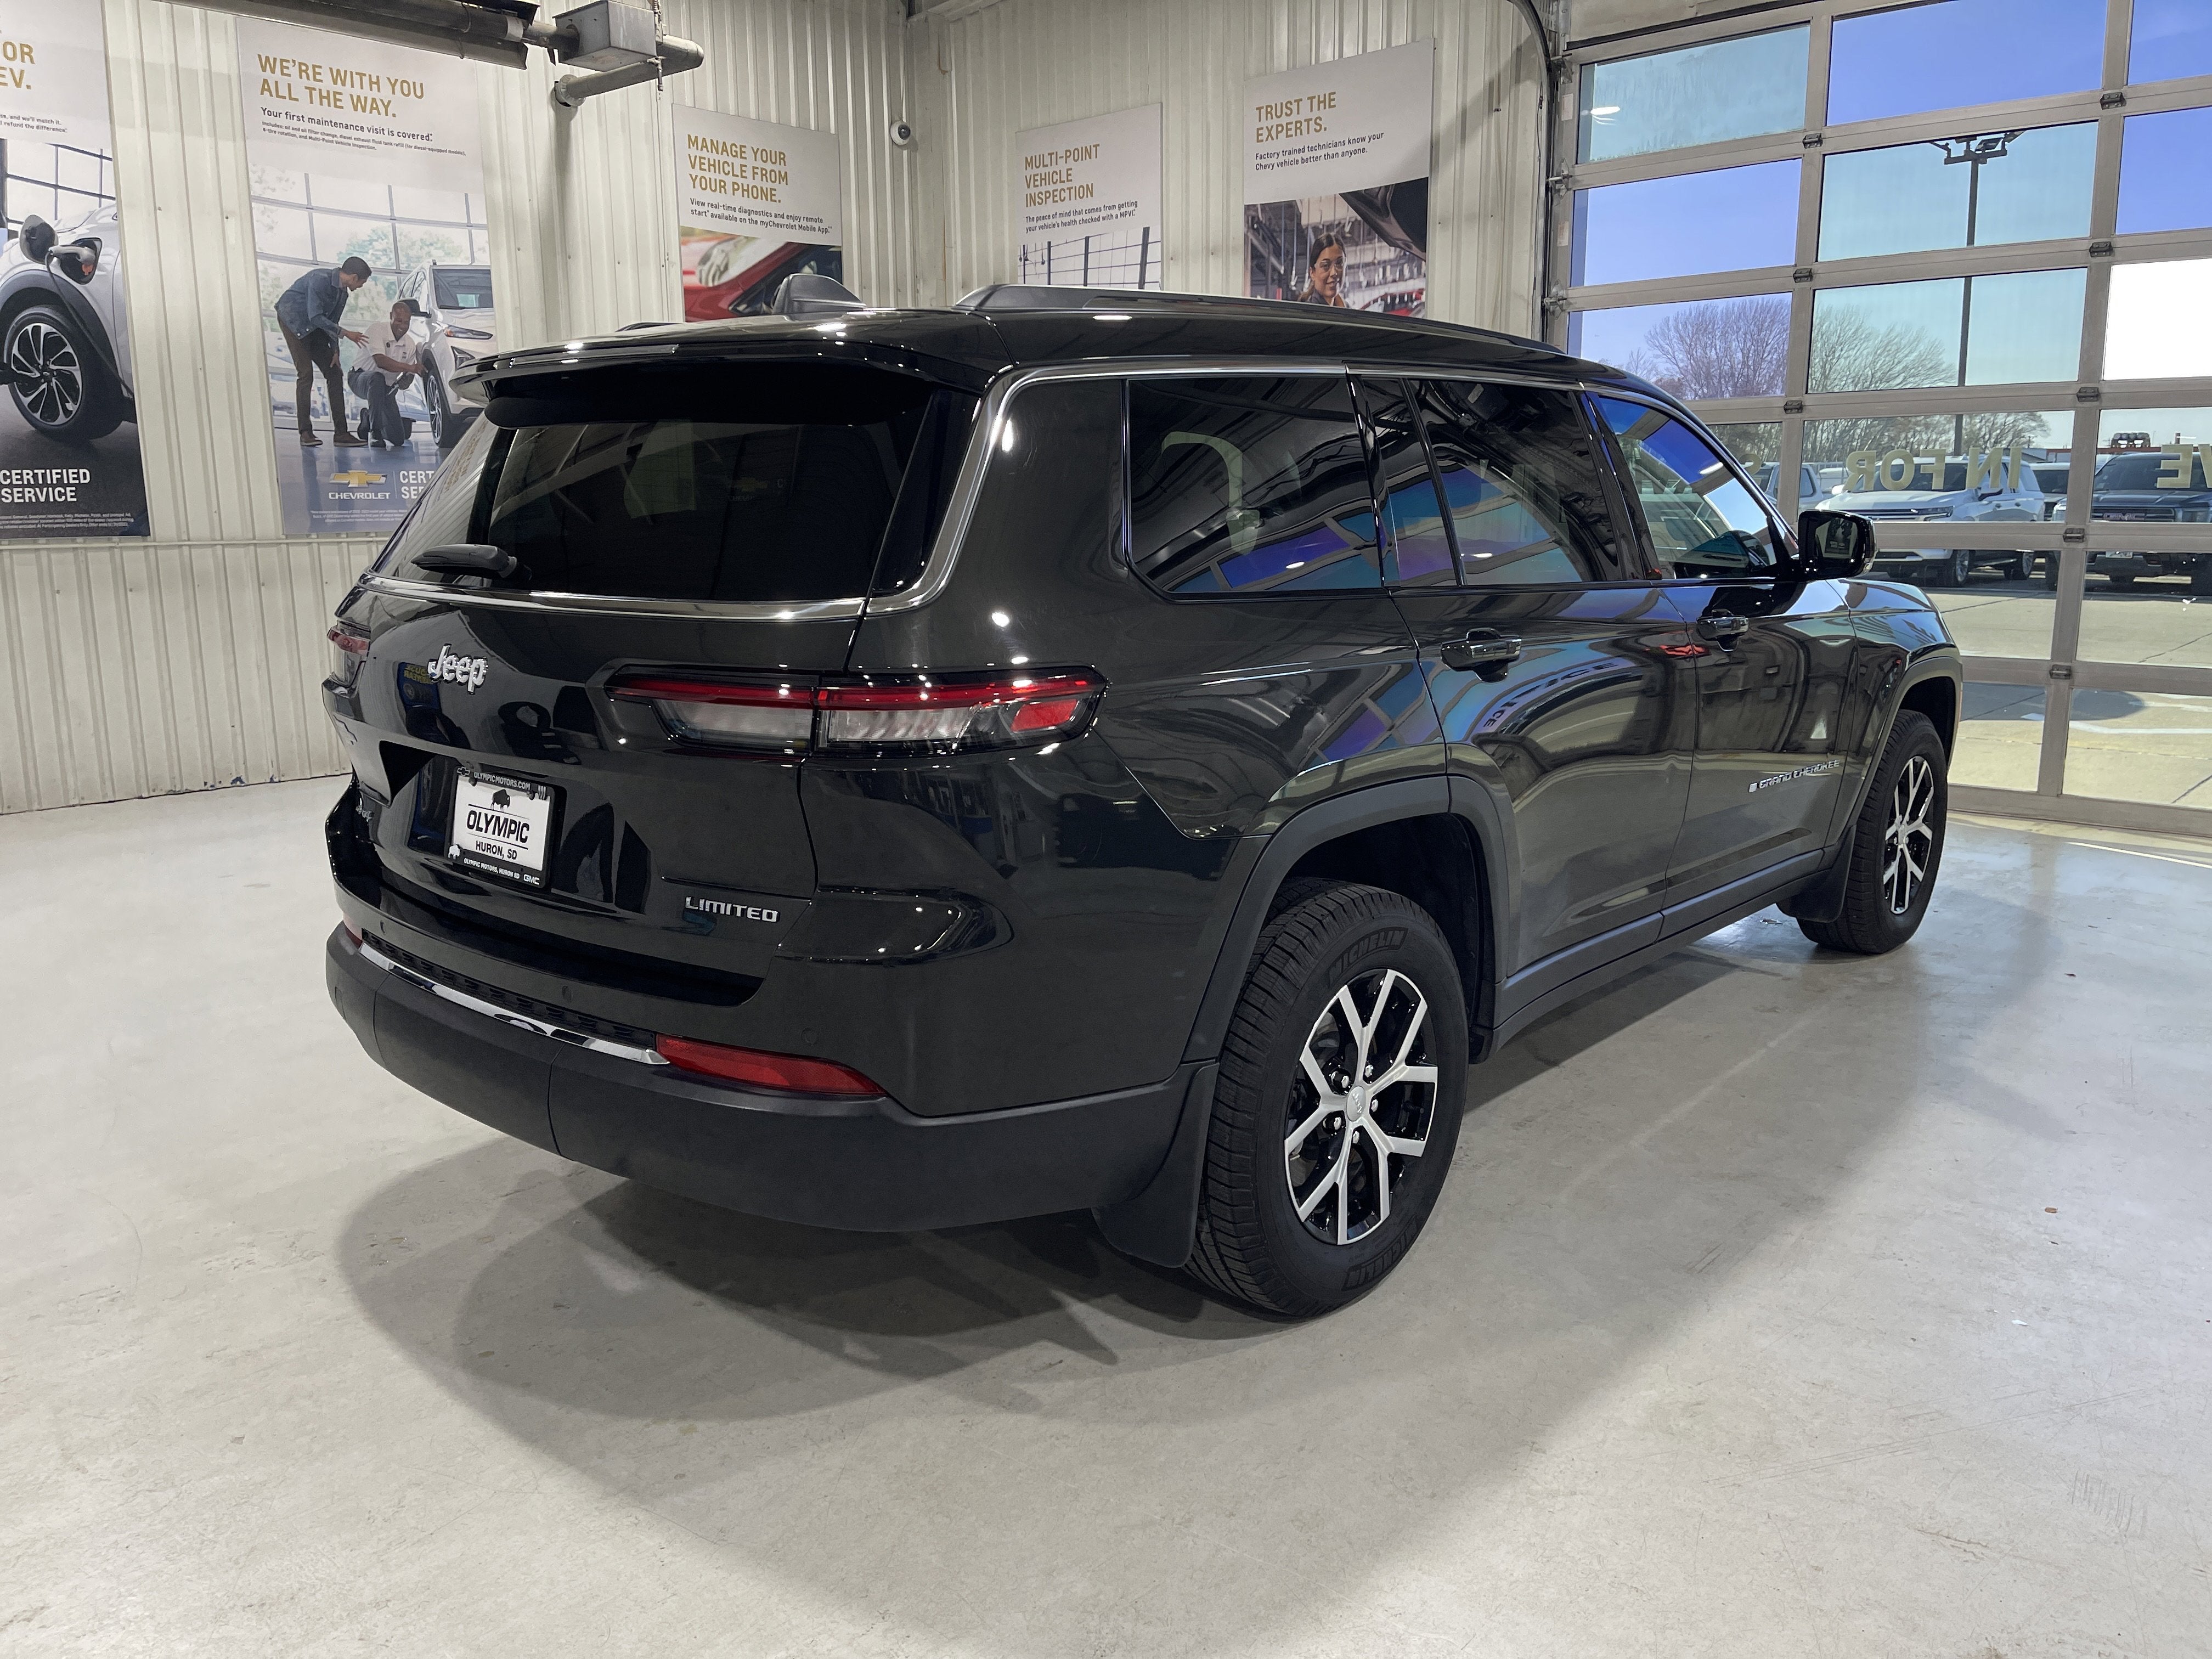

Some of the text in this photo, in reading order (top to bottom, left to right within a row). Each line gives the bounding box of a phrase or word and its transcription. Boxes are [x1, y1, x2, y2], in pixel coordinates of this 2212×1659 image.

[257, 54, 425, 100] WE'RE WITH YOU
[259, 78, 397, 117] ALL THE WAY.
[1256, 91, 1336, 122] TRUST THE
[261, 106, 283, 119] Your
[285, 111, 305, 123] first
[307, 116, 365, 132] maintenance
[366, 125, 385, 136] visit
[387, 127, 394, 137] is
[1256, 116, 1327, 143] EXPERTS.
[687, 134, 787, 167] MANAGE YOUR
[1024, 143, 1100, 171] MULTI-POINT
[1255, 132, 1385, 160] Factory trained technicians know your
[1255, 146, 1368, 171] Chevy vehicle better than anyone.
[688, 154, 788, 185] VEHICLE FROM
[1025, 167, 1073, 189] VEHICLE
[689, 173, 782, 204] YOUR PHONE.
[1025, 183, 1094, 208] INSPECTION
[690, 198, 706, 207] View
[707, 201, 737, 212] real-time
[738, 206, 772, 218] diagnostics
[786, 214, 802, 223] enjoy
[803, 216, 823, 224] remote
[710, 212, 738, 223] available
[759, 218, 797, 230] myChevrolet
[798, 223, 816, 232] Mobile
[1025, 225, 1037, 234] your
[1038, 221, 1060, 230] vehicle's
[1061, 218, 1077, 227] health
[1078, 215, 1101, 225] checked
[1036, 215, 1051, 223] peace
[1058, 210, 1071, 218] mind
[1118, 200, 1138, 211] getting
[0, 469, 91, 485] CERTIFIED
[1, 487, 77, 503] SERVICE
[2103, 512, 2145, 521] GMC
[427, 644, 488, 695] Jeep
[1759, 759, 1840, 789] GRAND CHEROKEE
[466, 810, 530, 843] OLYMPIC
[476, 840, 517, 860] HURON, SD
[464, 857, 481, 867] OLYMPIC
[499, 868, 514, 877] HURON
[523, 873, 540, 885] GMC
[685, 896, 779, 923] LIMITED
